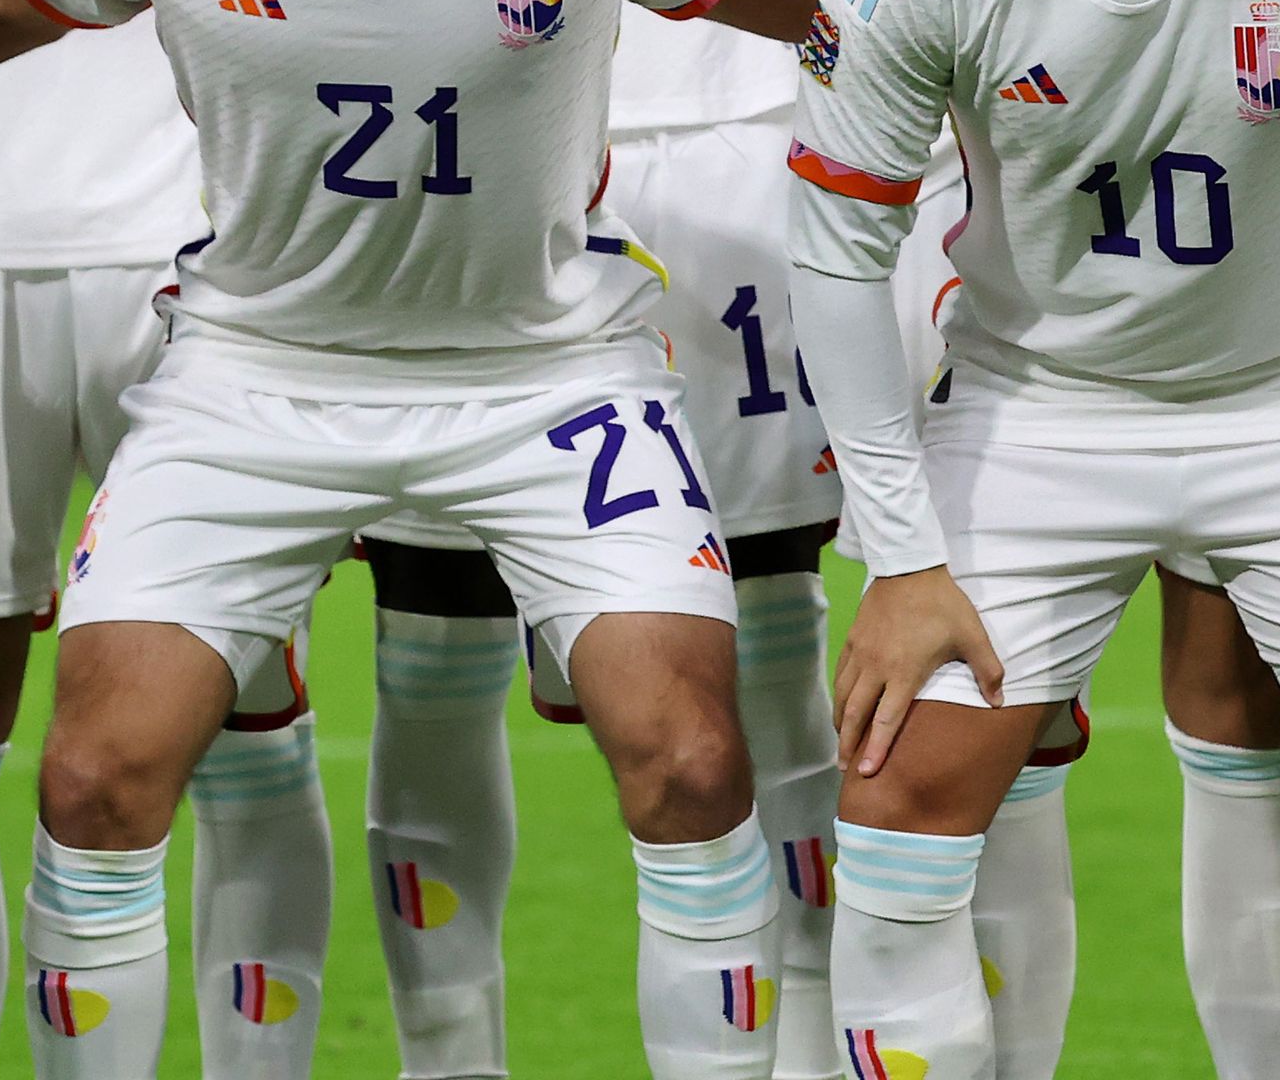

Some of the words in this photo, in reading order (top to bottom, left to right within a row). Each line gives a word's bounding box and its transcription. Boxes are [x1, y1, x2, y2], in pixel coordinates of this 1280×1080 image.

[316, 83, 472, 198] 21
[1076, 151, 1235, 265] 10
[721, 285, 816, 417] 1
[547, 400, 712, 530] 21
